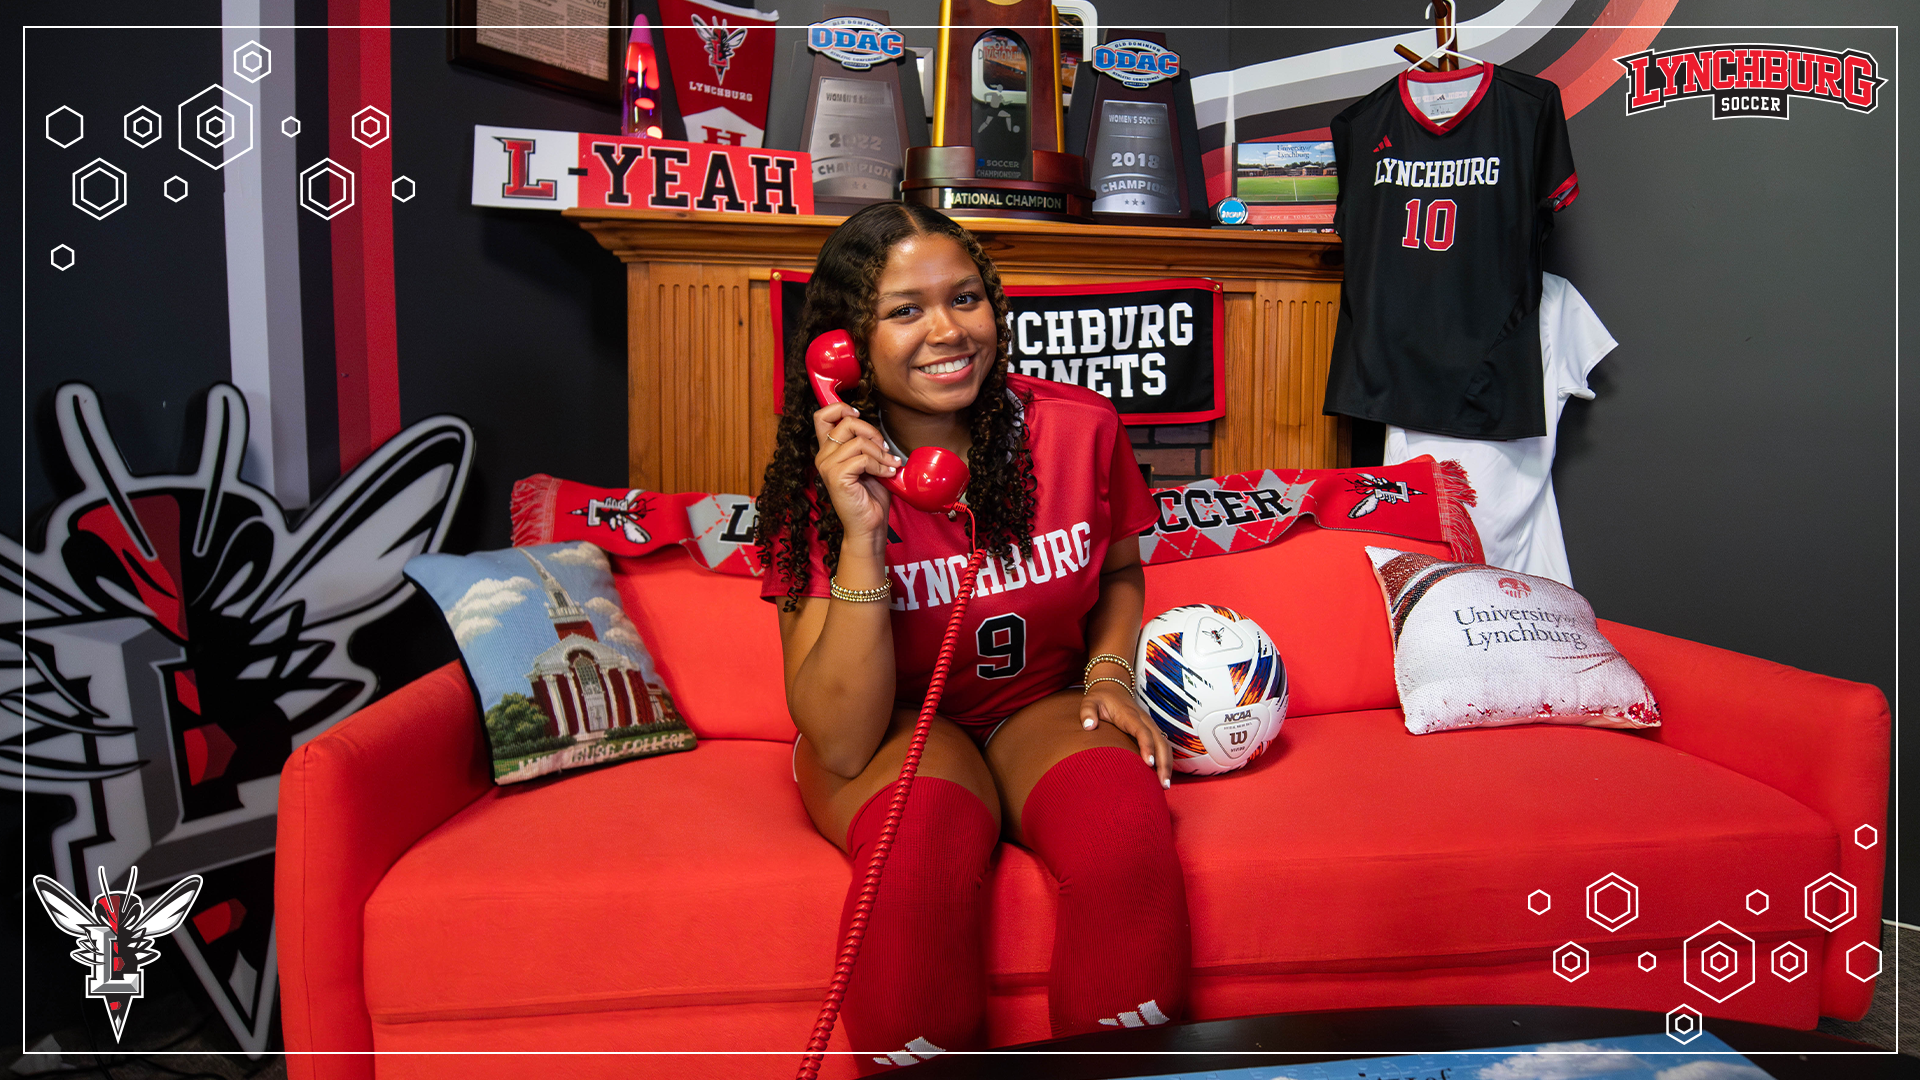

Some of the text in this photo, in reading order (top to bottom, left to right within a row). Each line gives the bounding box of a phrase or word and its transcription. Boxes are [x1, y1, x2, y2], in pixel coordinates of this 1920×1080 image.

[809, 25, 903, 58] ODAC
[978, 48, 1013, 61] DIVISION
[1094, 46, 1180, 78] ODAC
[688, 81, 754, 102] LYNCHBURG
[986, 159, 1020, 169] SOCCER
[1111, 151, 1161, 169] 2018
[1277, 151, 1310, 160] Lynchburg
[817, 161, 893, 179] CHAMPION
[976, 169, 1021, 179] CHAMPIONSHIP
[1374, 157, 1500, 187] LYNCHBURG
[1101, 179, 1169, 196] CHAMPION
[1005, 194, 1062, 209] CHAMPION
[1402, 199, 1457, 251] 10
[1007, 302, 1193, 355] CHBURG
[1007, 352, 1167, 399] NETS
[1140, 488, 1293, 537] CCER
[1453, 604, 1562, 628] University
[975, 612, 1026, 680] 9
[1462, 622, 1588, 651] Lynchburg
[1224, 709, 1252, 723] NCAA
